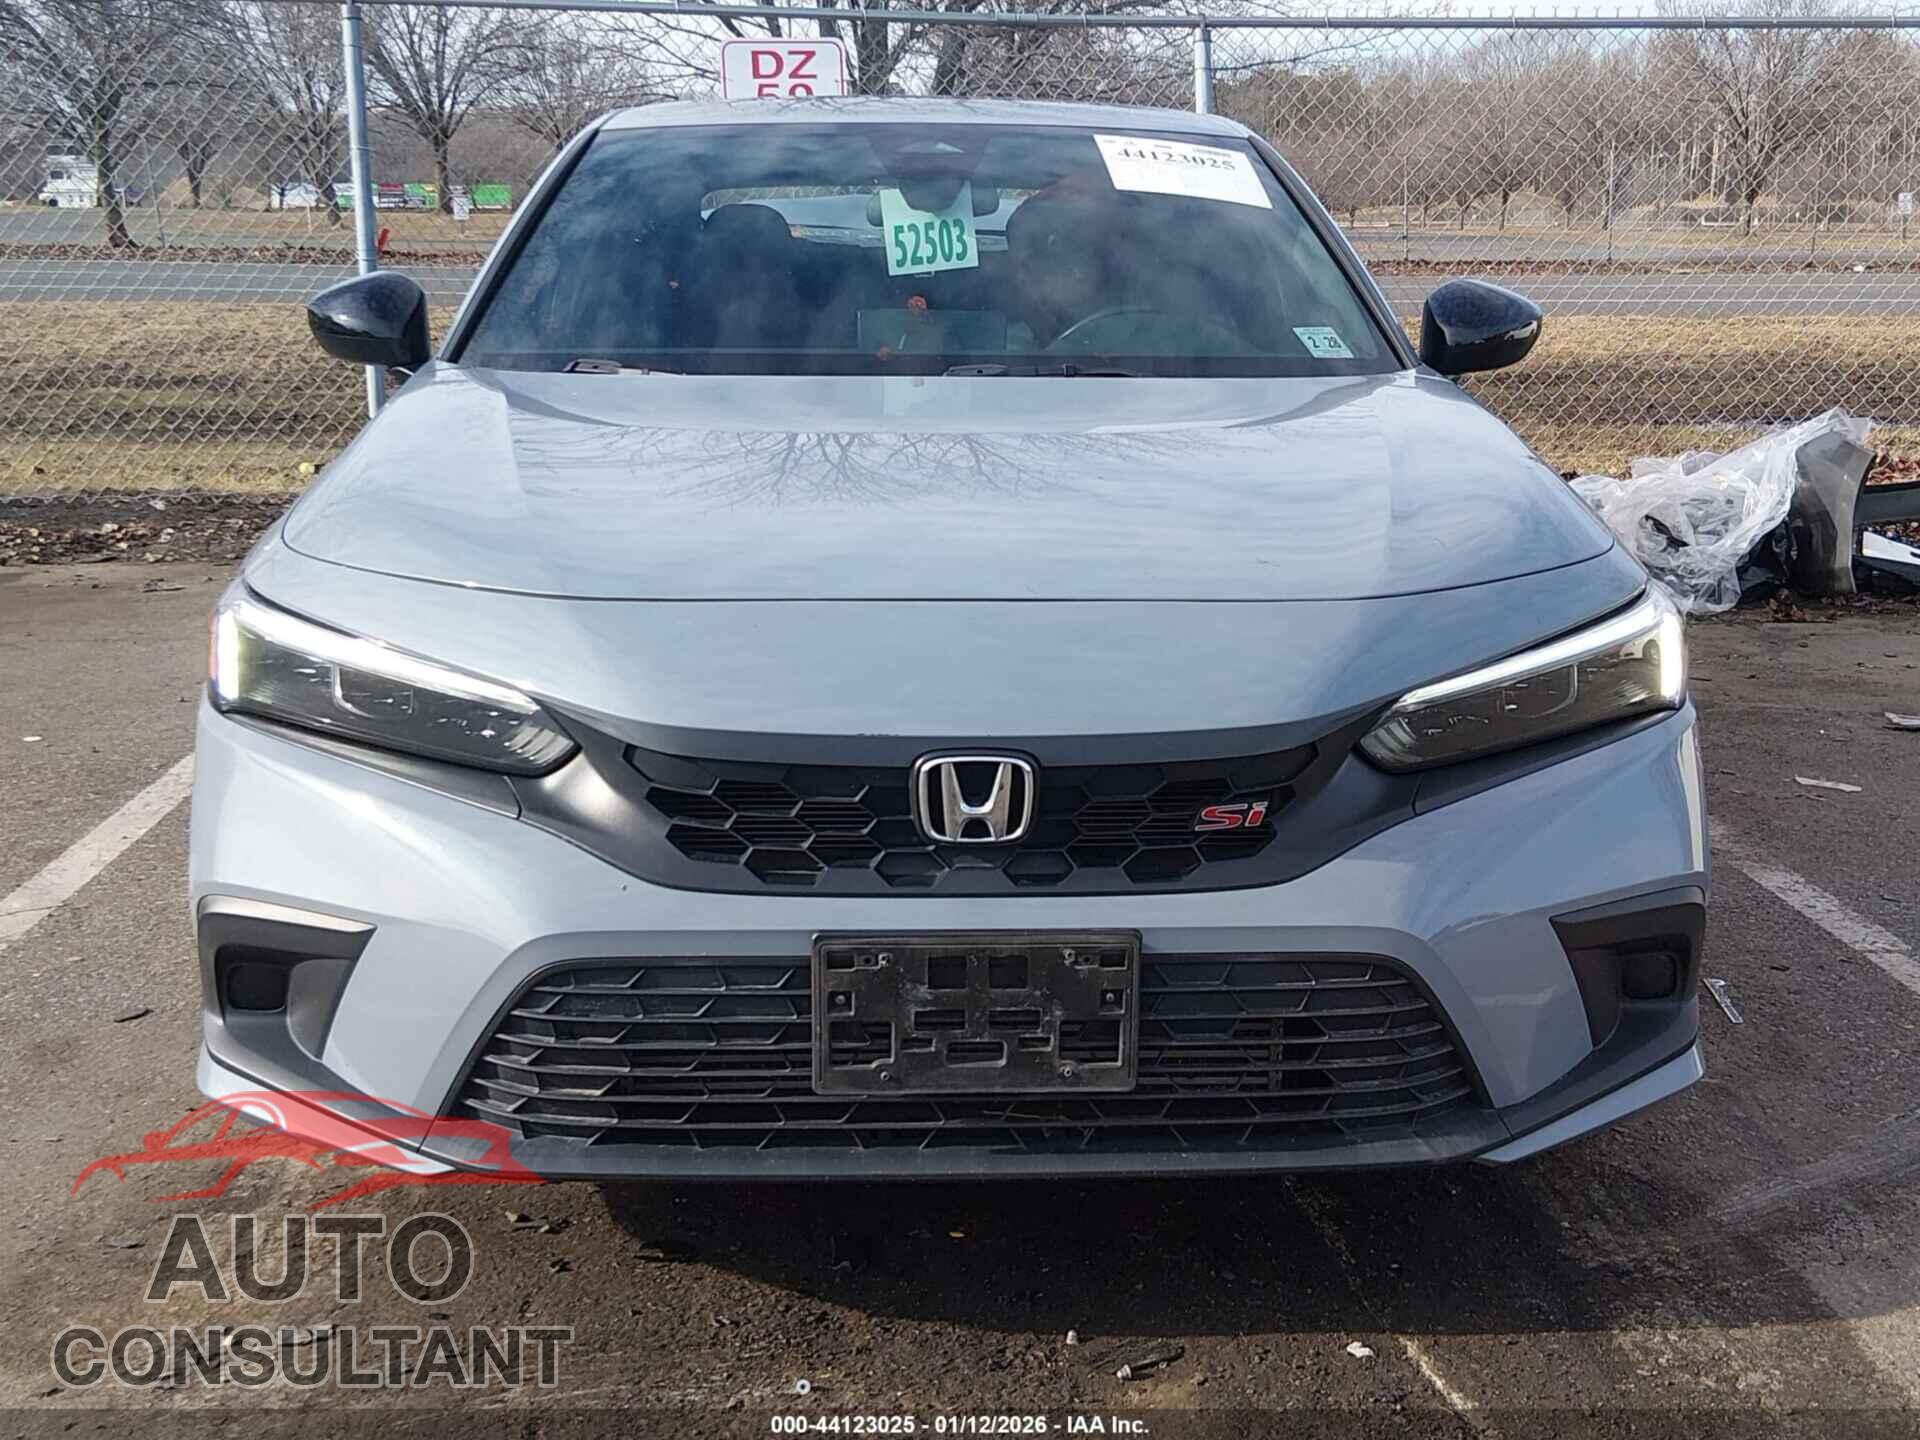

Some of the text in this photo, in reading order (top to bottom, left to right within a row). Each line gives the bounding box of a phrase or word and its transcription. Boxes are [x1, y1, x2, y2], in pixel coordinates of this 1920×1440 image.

[751, 50, 818, 80] DZ
[1117, 148, 1236, 171] 44123025
[894, 218, 968, 268] 52503
[1195, 801, 1268, 831] Si
